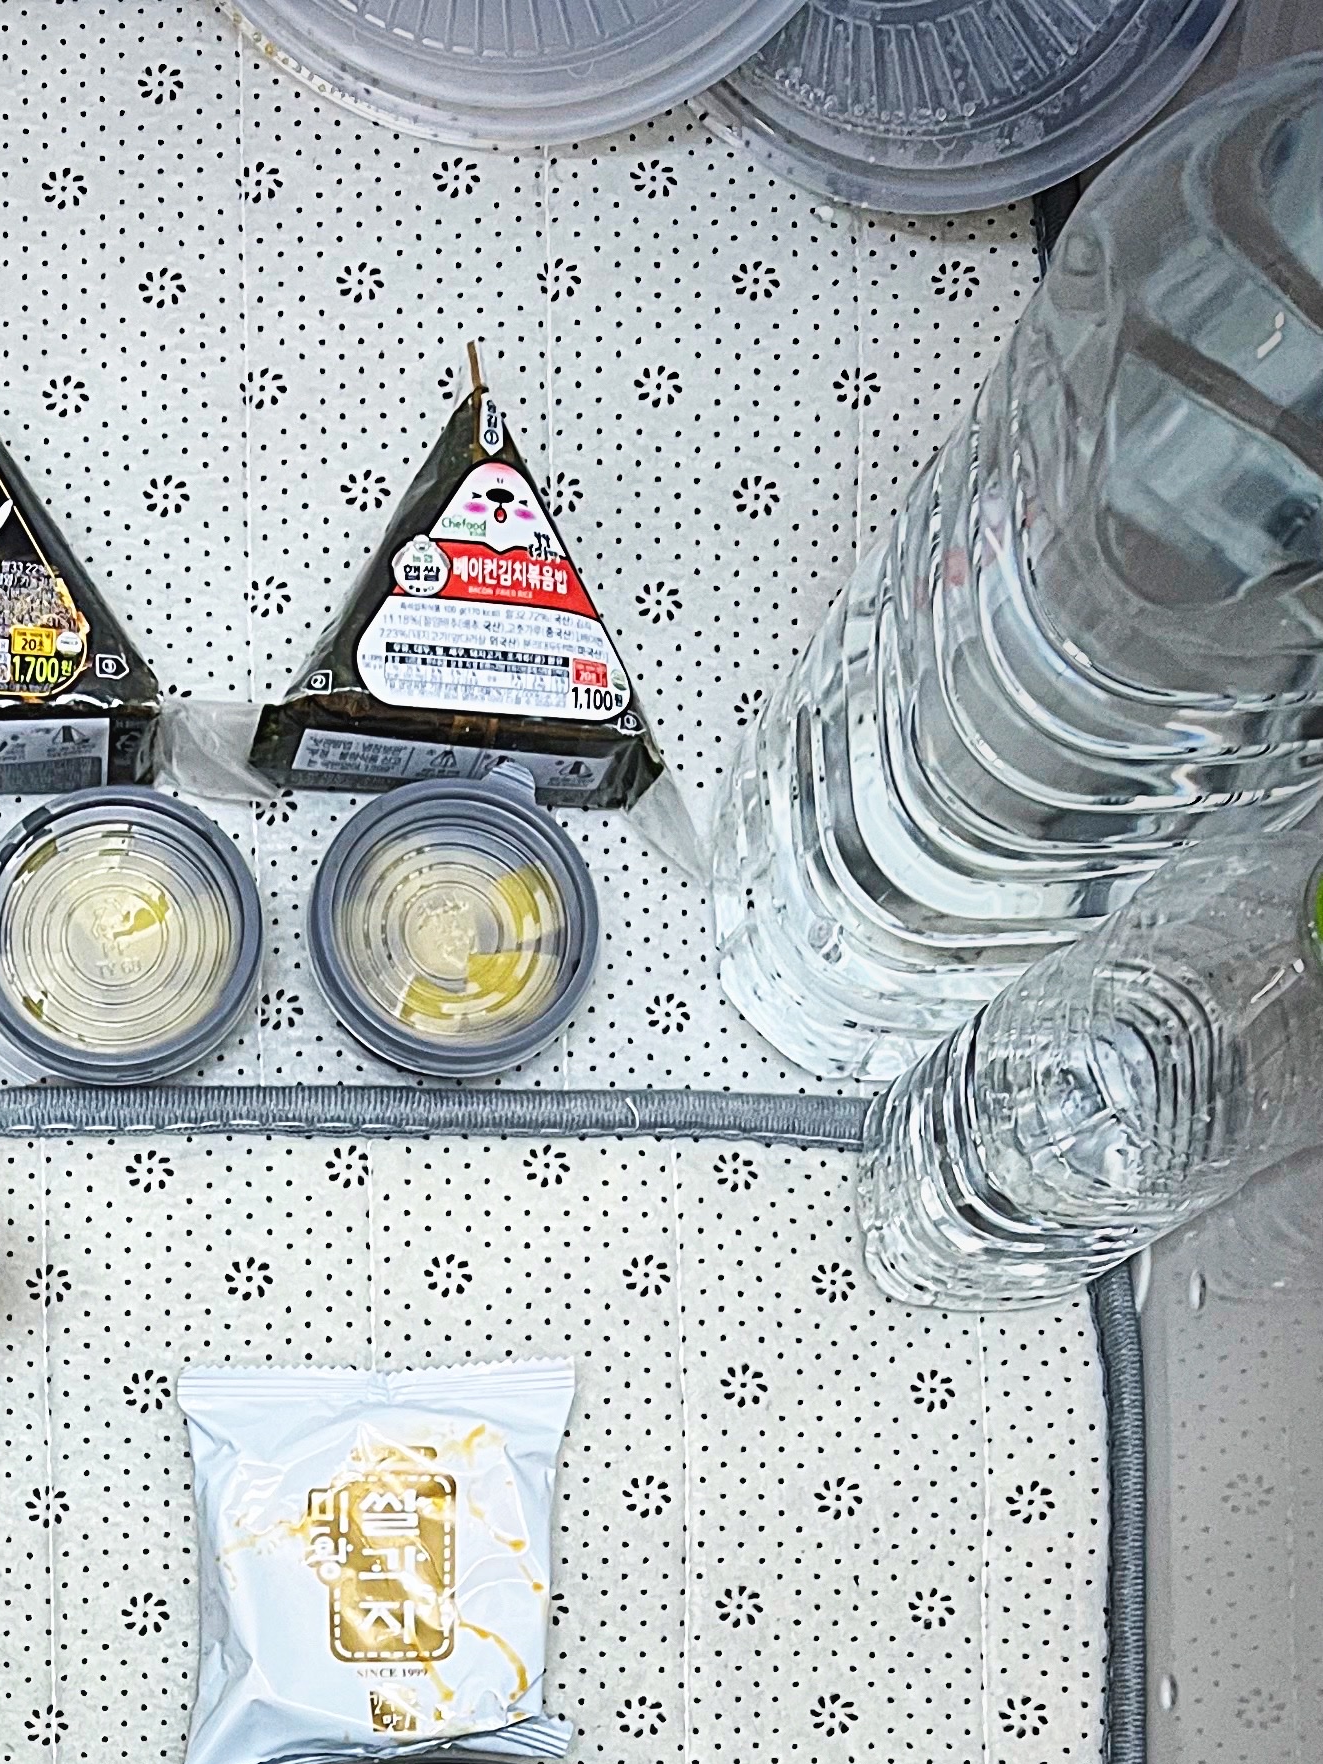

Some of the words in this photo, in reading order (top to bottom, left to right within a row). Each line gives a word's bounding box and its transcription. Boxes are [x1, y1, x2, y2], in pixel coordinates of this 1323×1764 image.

[441, 517, 487, 531] Chefood
[452, 555, 568, 595] 베이컨김치볶음밥
[356, 1667, 398, 1678] SINCE
[401, 1667, 429, 1678] 1999
